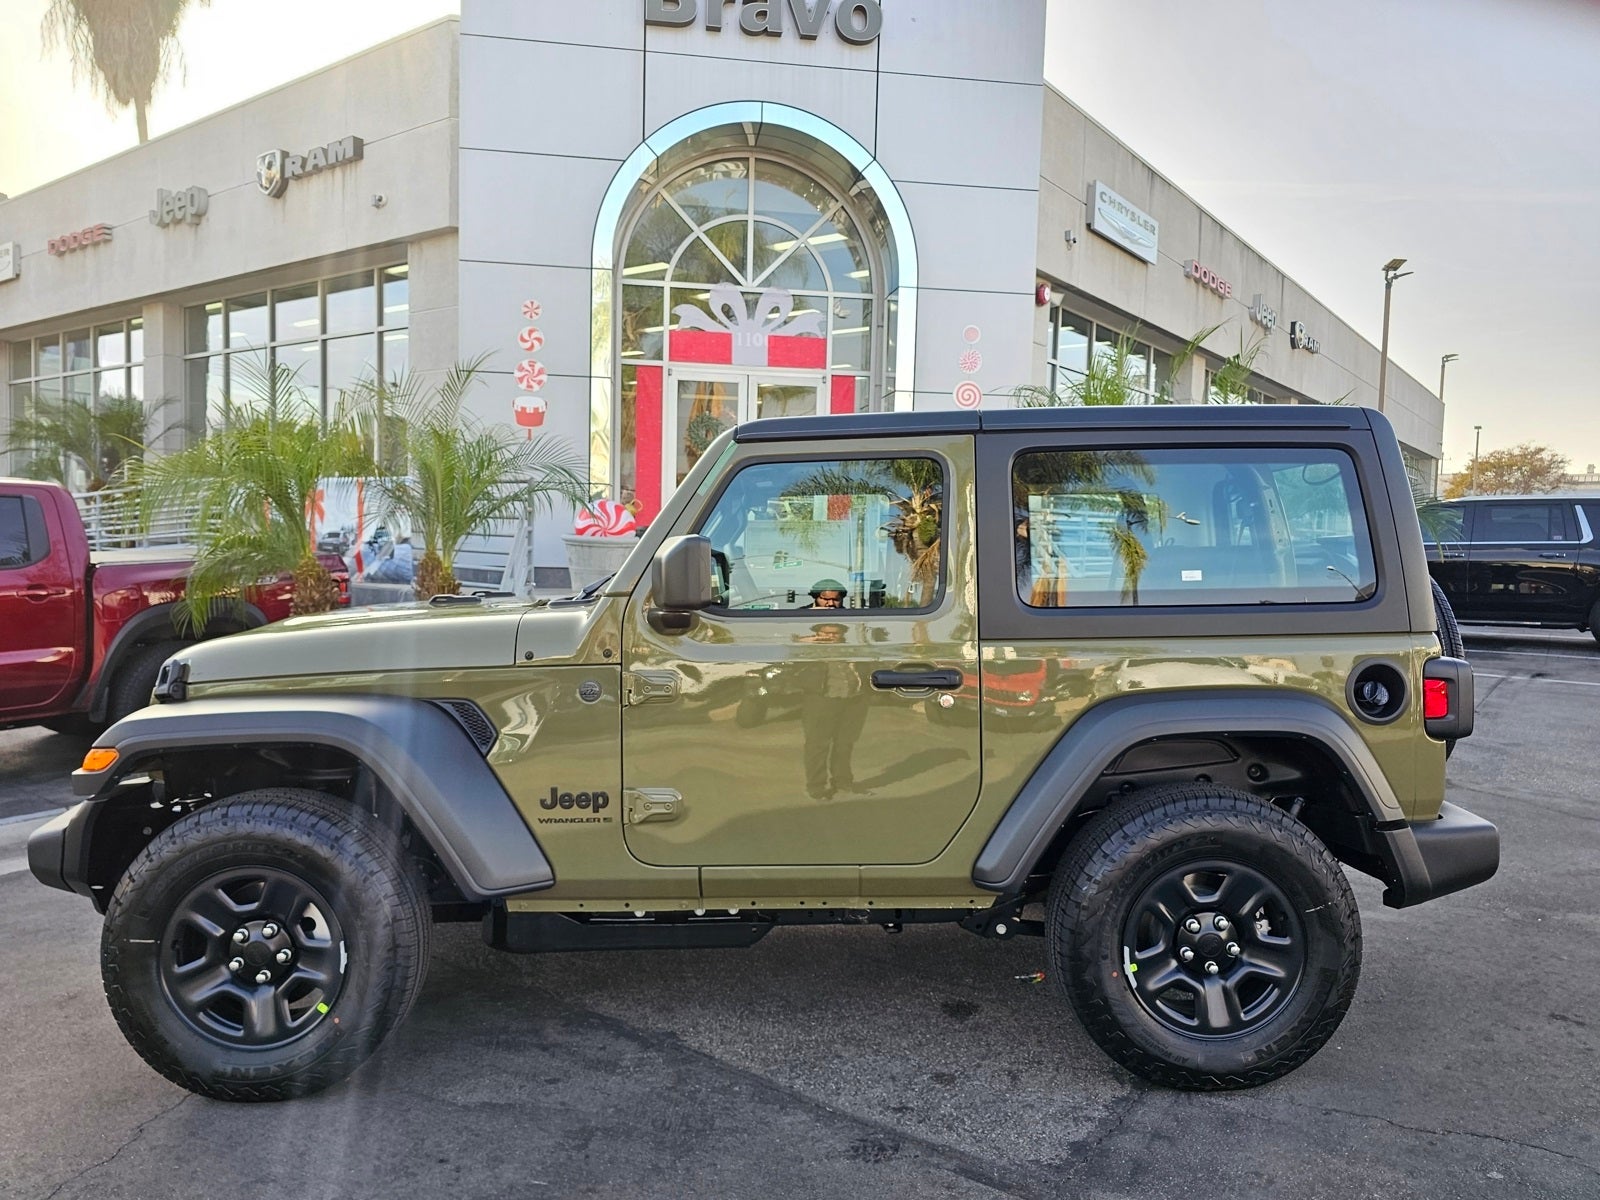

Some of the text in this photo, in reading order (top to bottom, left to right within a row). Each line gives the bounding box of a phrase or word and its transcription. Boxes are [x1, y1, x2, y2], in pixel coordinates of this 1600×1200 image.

[285, 135, 363, 180] RAM
[150, 186, 208, 228] Jeep
[1099, 191, 1156, 236] CHRYSLER
[48, 223, 112, 256] DODGE
[1190, 259, 1232, 299] DODGE
[1251, 294, 1277, 335] Jeep
[737, 332, 768, 348] 110
[539, 786, 610, 813] Jeep
